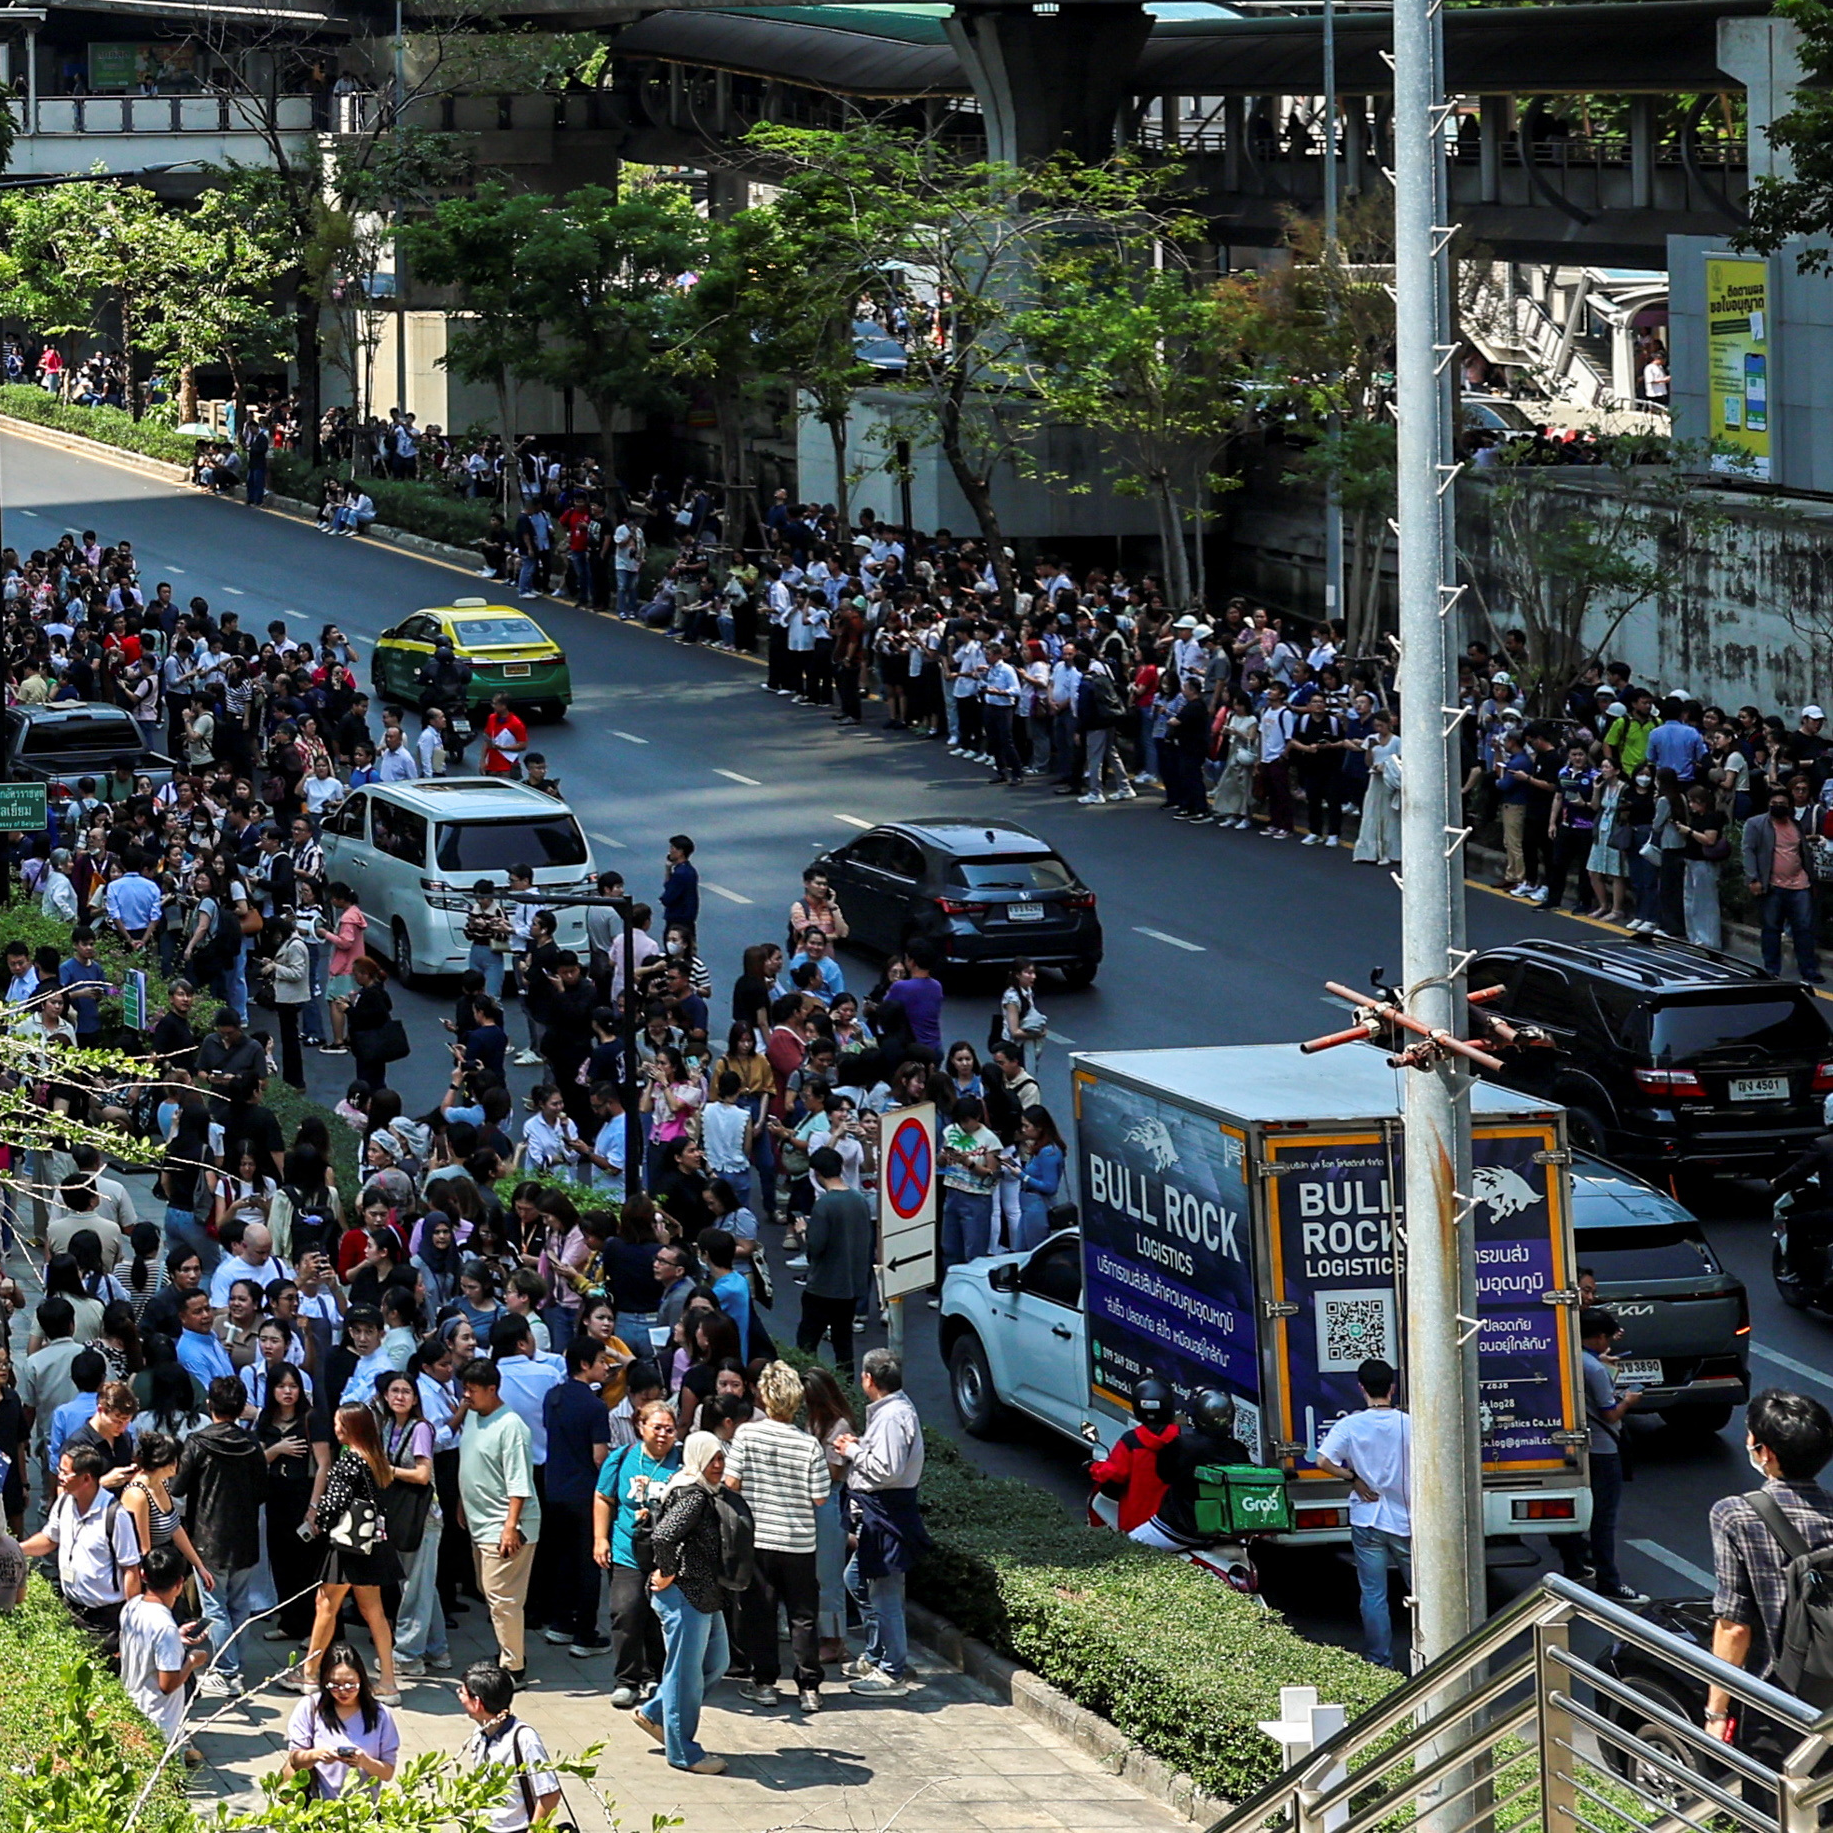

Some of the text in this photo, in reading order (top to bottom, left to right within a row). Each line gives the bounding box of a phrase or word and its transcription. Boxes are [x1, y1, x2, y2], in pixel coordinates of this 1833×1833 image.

[1710, 295, 1764, 316] ขอใบอนุญาต
[1756, 1079, 1779, 1090] 4501
[1089, 1153, 1241, 1263] BULL ROCK
[1299, 1180, 1404, 1217] BULL
[1302, 1219, 1405, 1255] ROCK
[1136, 1232, 1194, 1276] LOGISTICS
[1474, 1244, 1529, 1263] ารขนส่ง
[1305, 1257, 1405, 1278] LOGISTICS
[1635, 1361, 1659, 1372] 3890
[1495, 1420, 1530, 1430] ogistics
[1242, 1495, 1279, 1512] Grab
